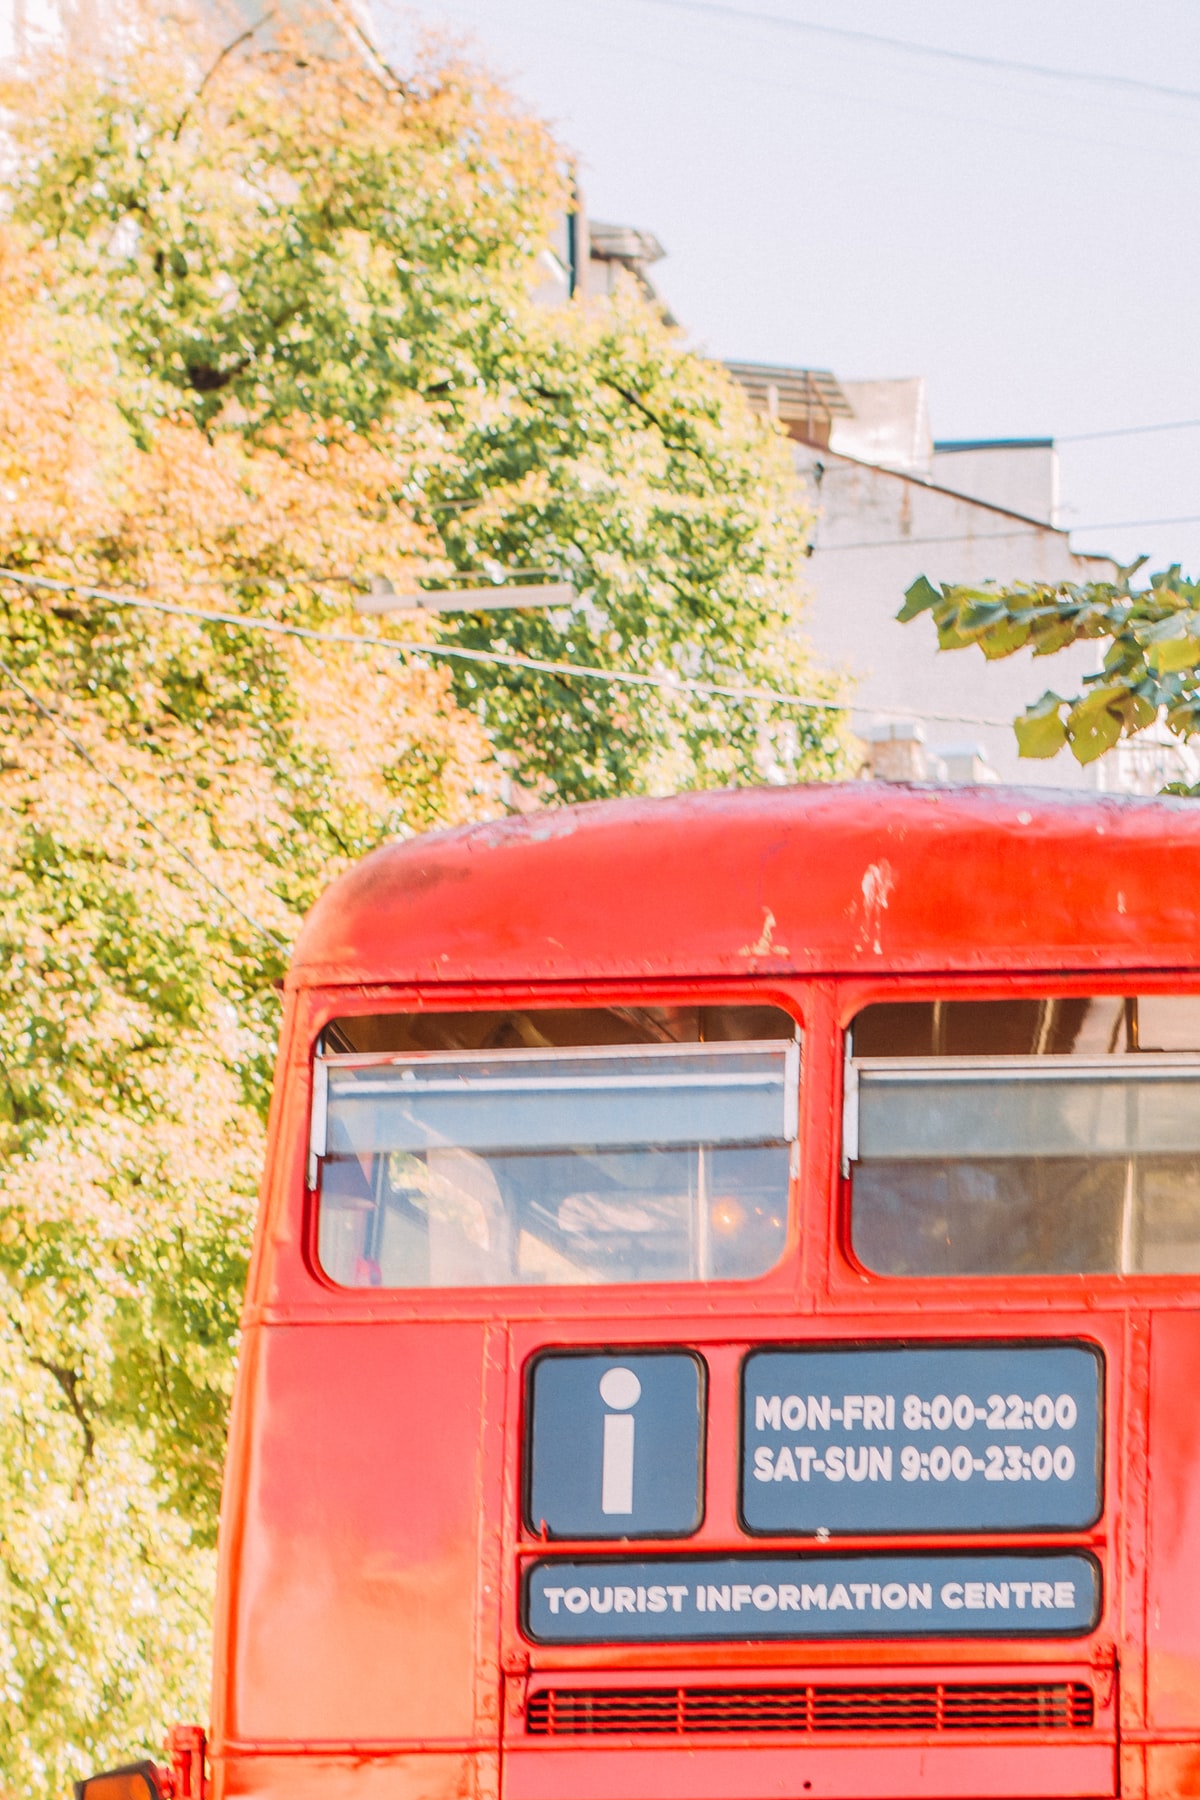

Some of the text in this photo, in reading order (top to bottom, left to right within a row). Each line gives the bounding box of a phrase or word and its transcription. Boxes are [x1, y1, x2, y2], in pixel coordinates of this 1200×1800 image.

[755, 1394, 1078, 1431] MON-FRI 8:00-22:00
[753, 1445, 1076, 1482] SAT-SUN 9:00-23:00
[544, 1582, 1076, 1614] TOURIST INFORMATION CENTRE
